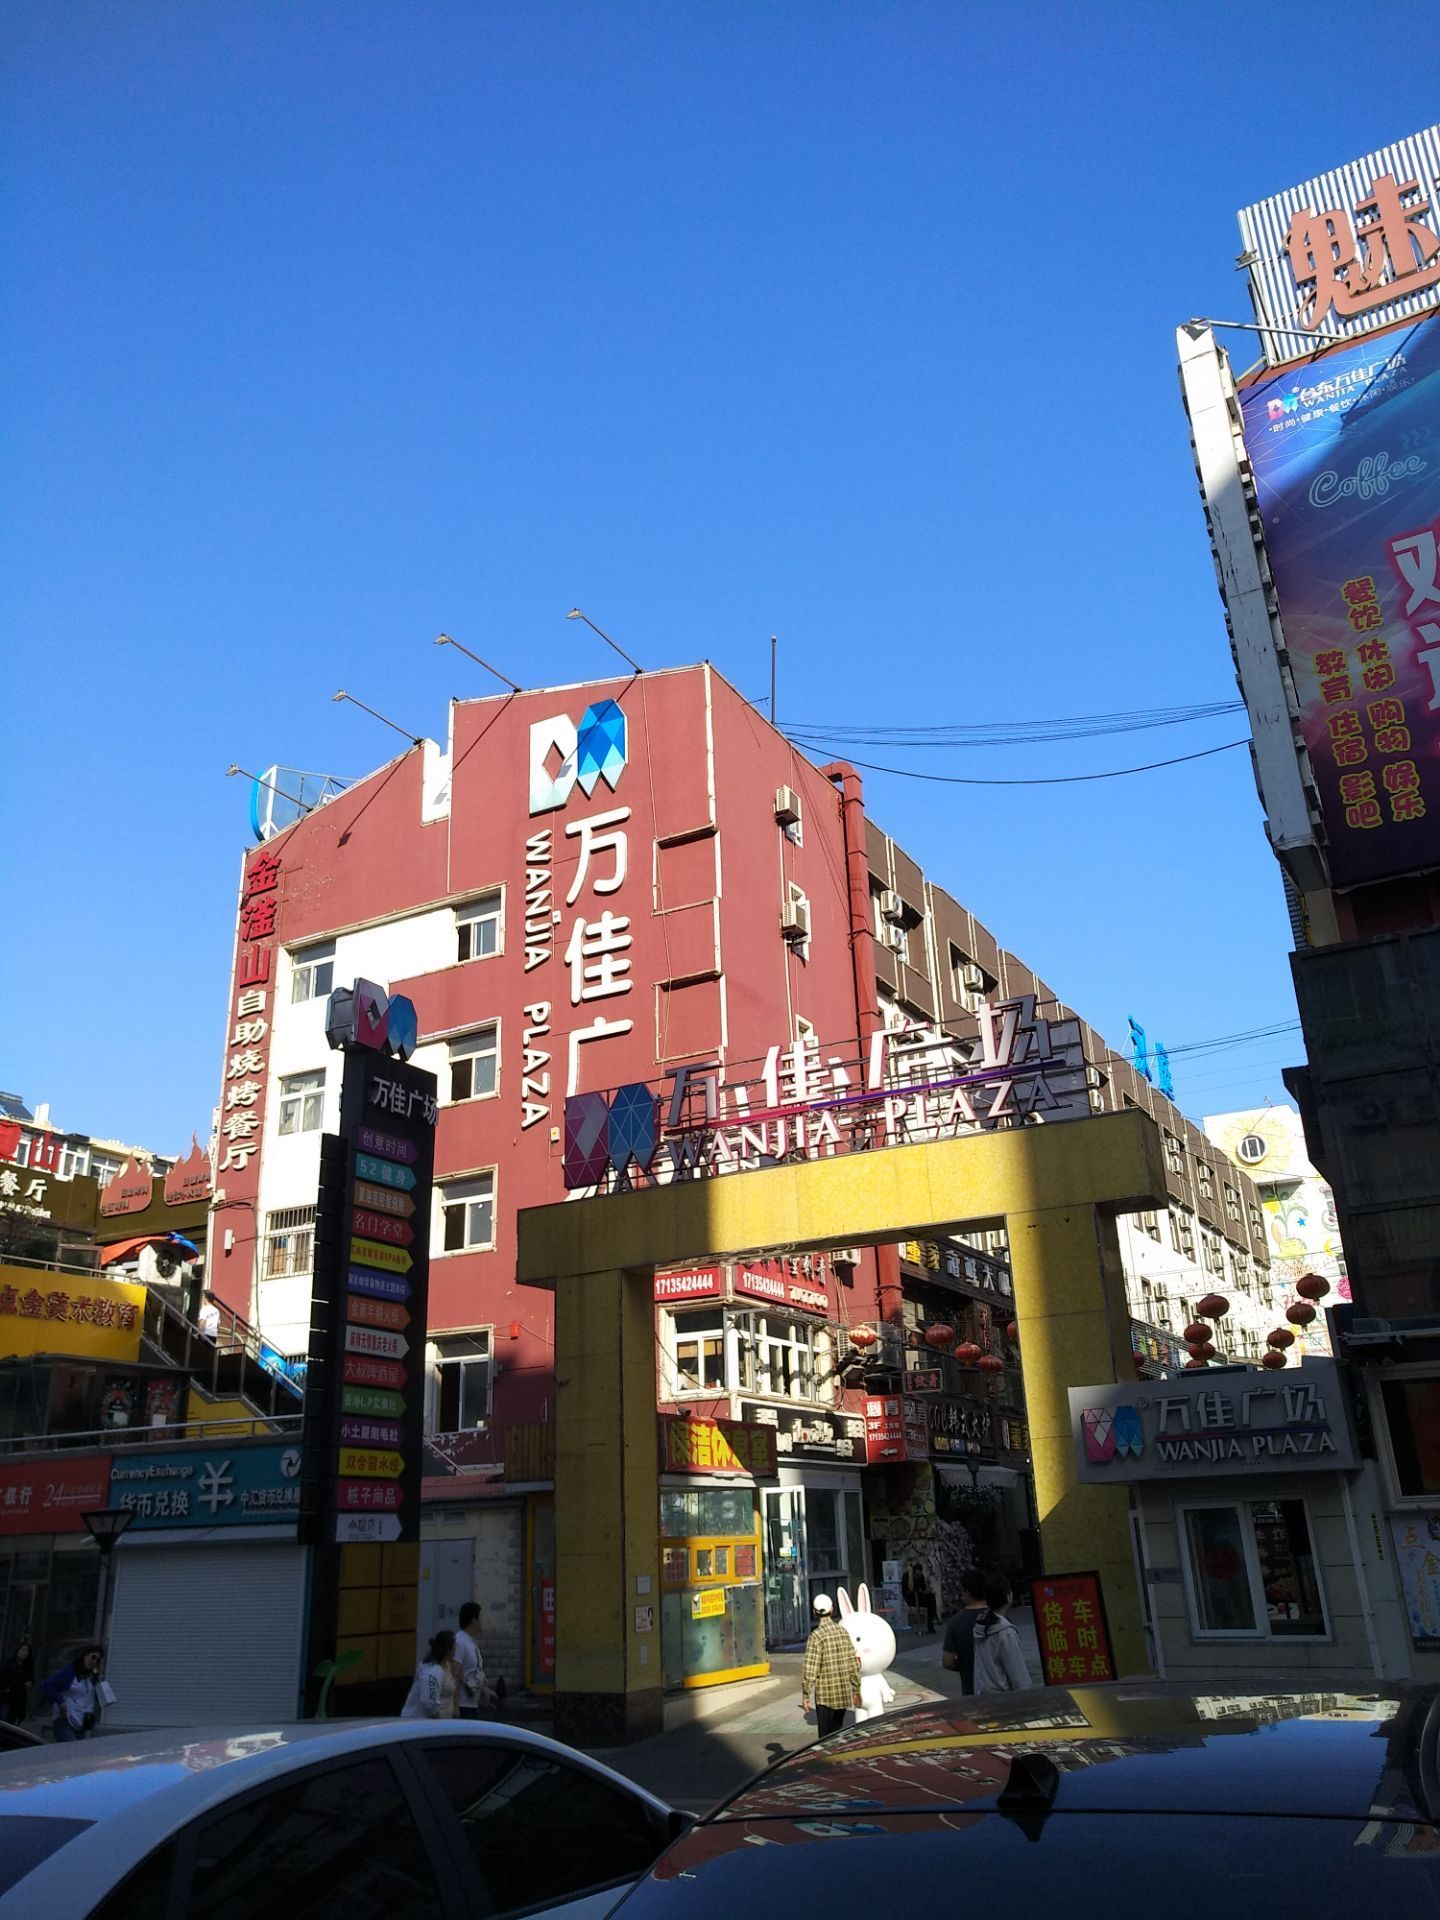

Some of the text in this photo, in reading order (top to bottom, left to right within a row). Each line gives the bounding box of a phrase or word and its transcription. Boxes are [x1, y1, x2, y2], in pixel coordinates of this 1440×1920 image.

[1299, 354, 1407, 403] 台东万佳广场
[1303, 384, 1356, 409] WANJIA
[1309, 451, 1428, 508] Coffee
[1342, 576, 1383, 632] 餐饮
[1315, 650, 1352, 705] 教育
[1356, 637, 1397, 692] 休闲
[1327, 709, 1368, 767] 住宿
[1368, 699, 1412, 753] 购物
[1383, 760, 1427, 822] 娱乐
[521, 829, 552, 1129] WANJIA PLAZA
[562, 806, 634, 1200] 万佳广
[665, 994, 1054, 1127] 万佳广场
[372, 1076, 439, 1126] 万佳广场
[667, 1074, 1067, 1174] WANJIA PLAZA
[362, 1130, 408, 1158] 创意时尚
[655, 1274, 714, 1295] 17135424444
[743, 1271, 785, 1298] 17135424444
[1154, 1382, 1328, 1434] 万佳广场
[1157, 1431, 1337, 1463] WANJIA PLAZA
[0, 1486, 33, 1505] 银行
[120, 1490, 189, 1518] 货币兑换
[1042, 1599, 1095, 1627] 货车
[1046, 1625, 1098, 1653] 临时
[1047, 1653, 1109, 1680] 停车点
